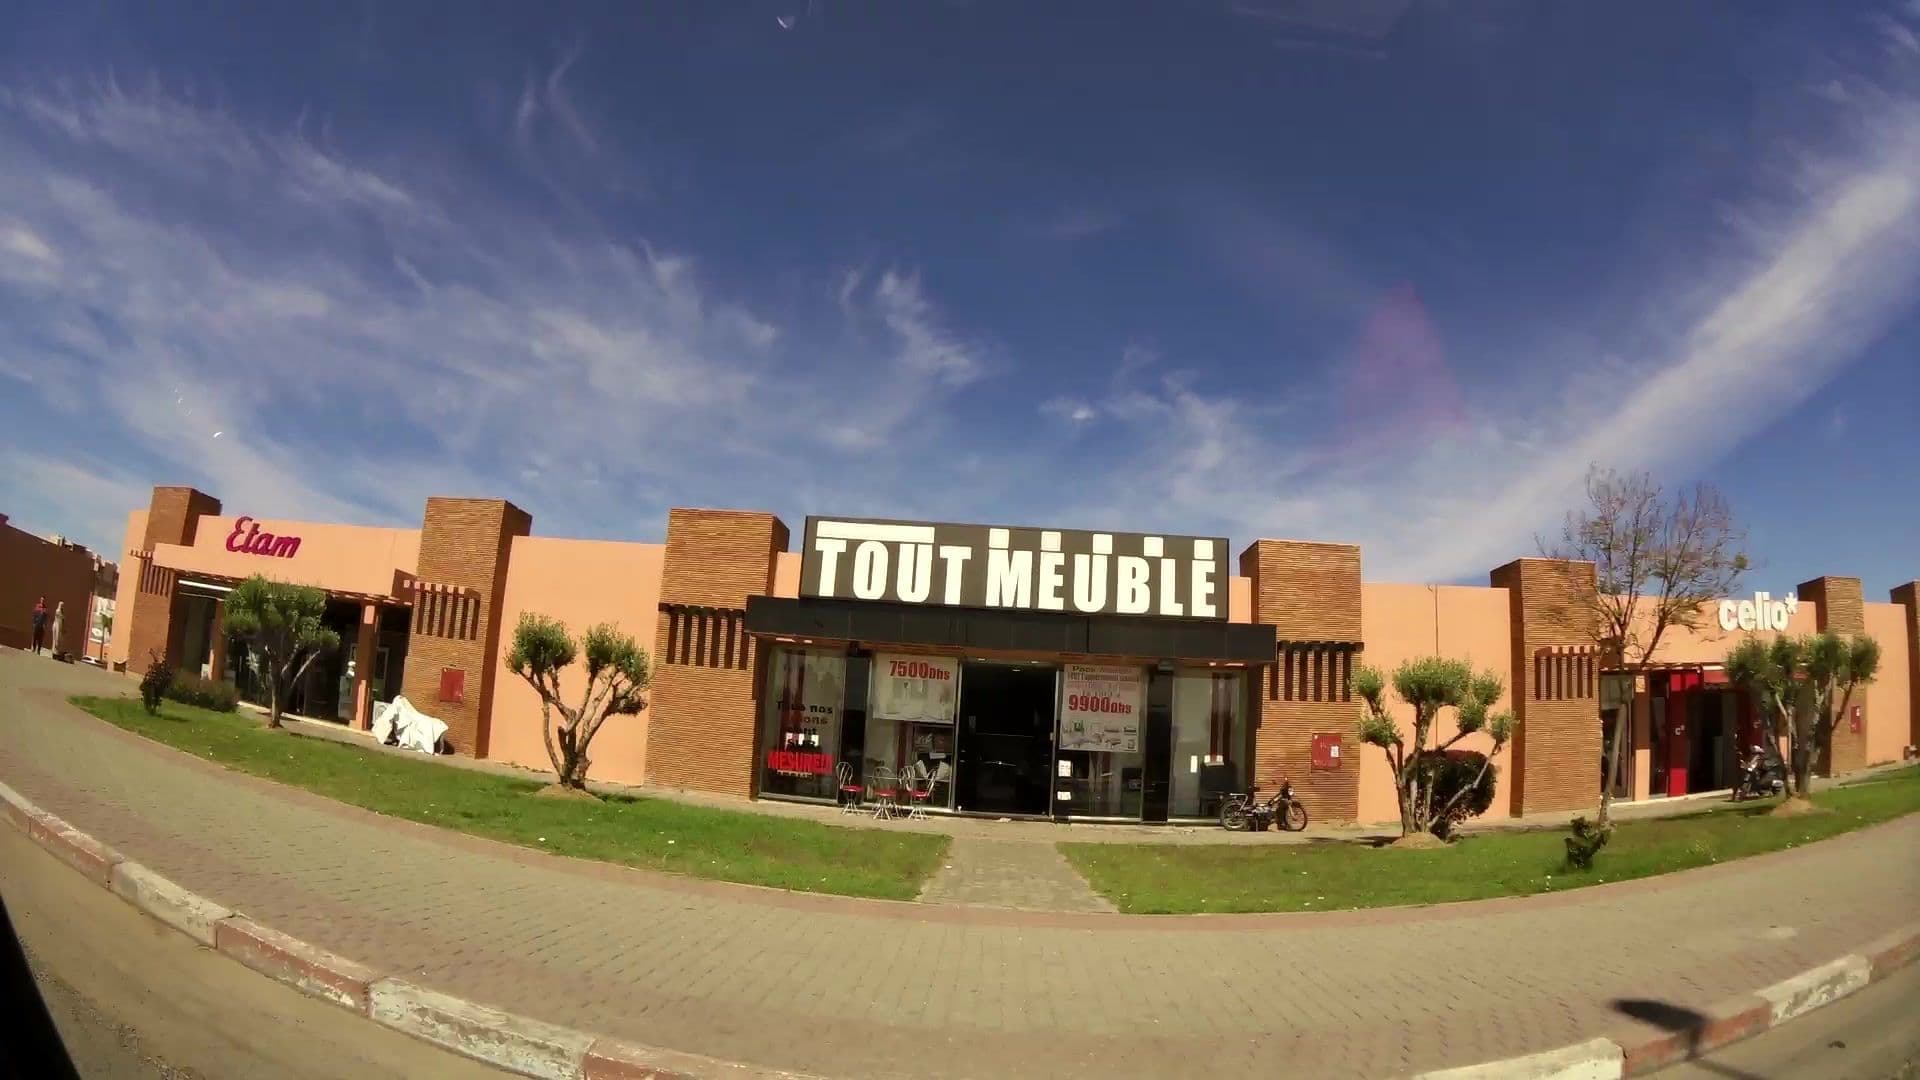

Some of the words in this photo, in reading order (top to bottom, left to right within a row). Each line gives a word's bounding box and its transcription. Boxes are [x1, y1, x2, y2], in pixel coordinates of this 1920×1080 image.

[226, 516, 302, 558] Etam
[815, 537, 973, 605] TOUT
[985, 548, 1218, 618] MEUBLE
